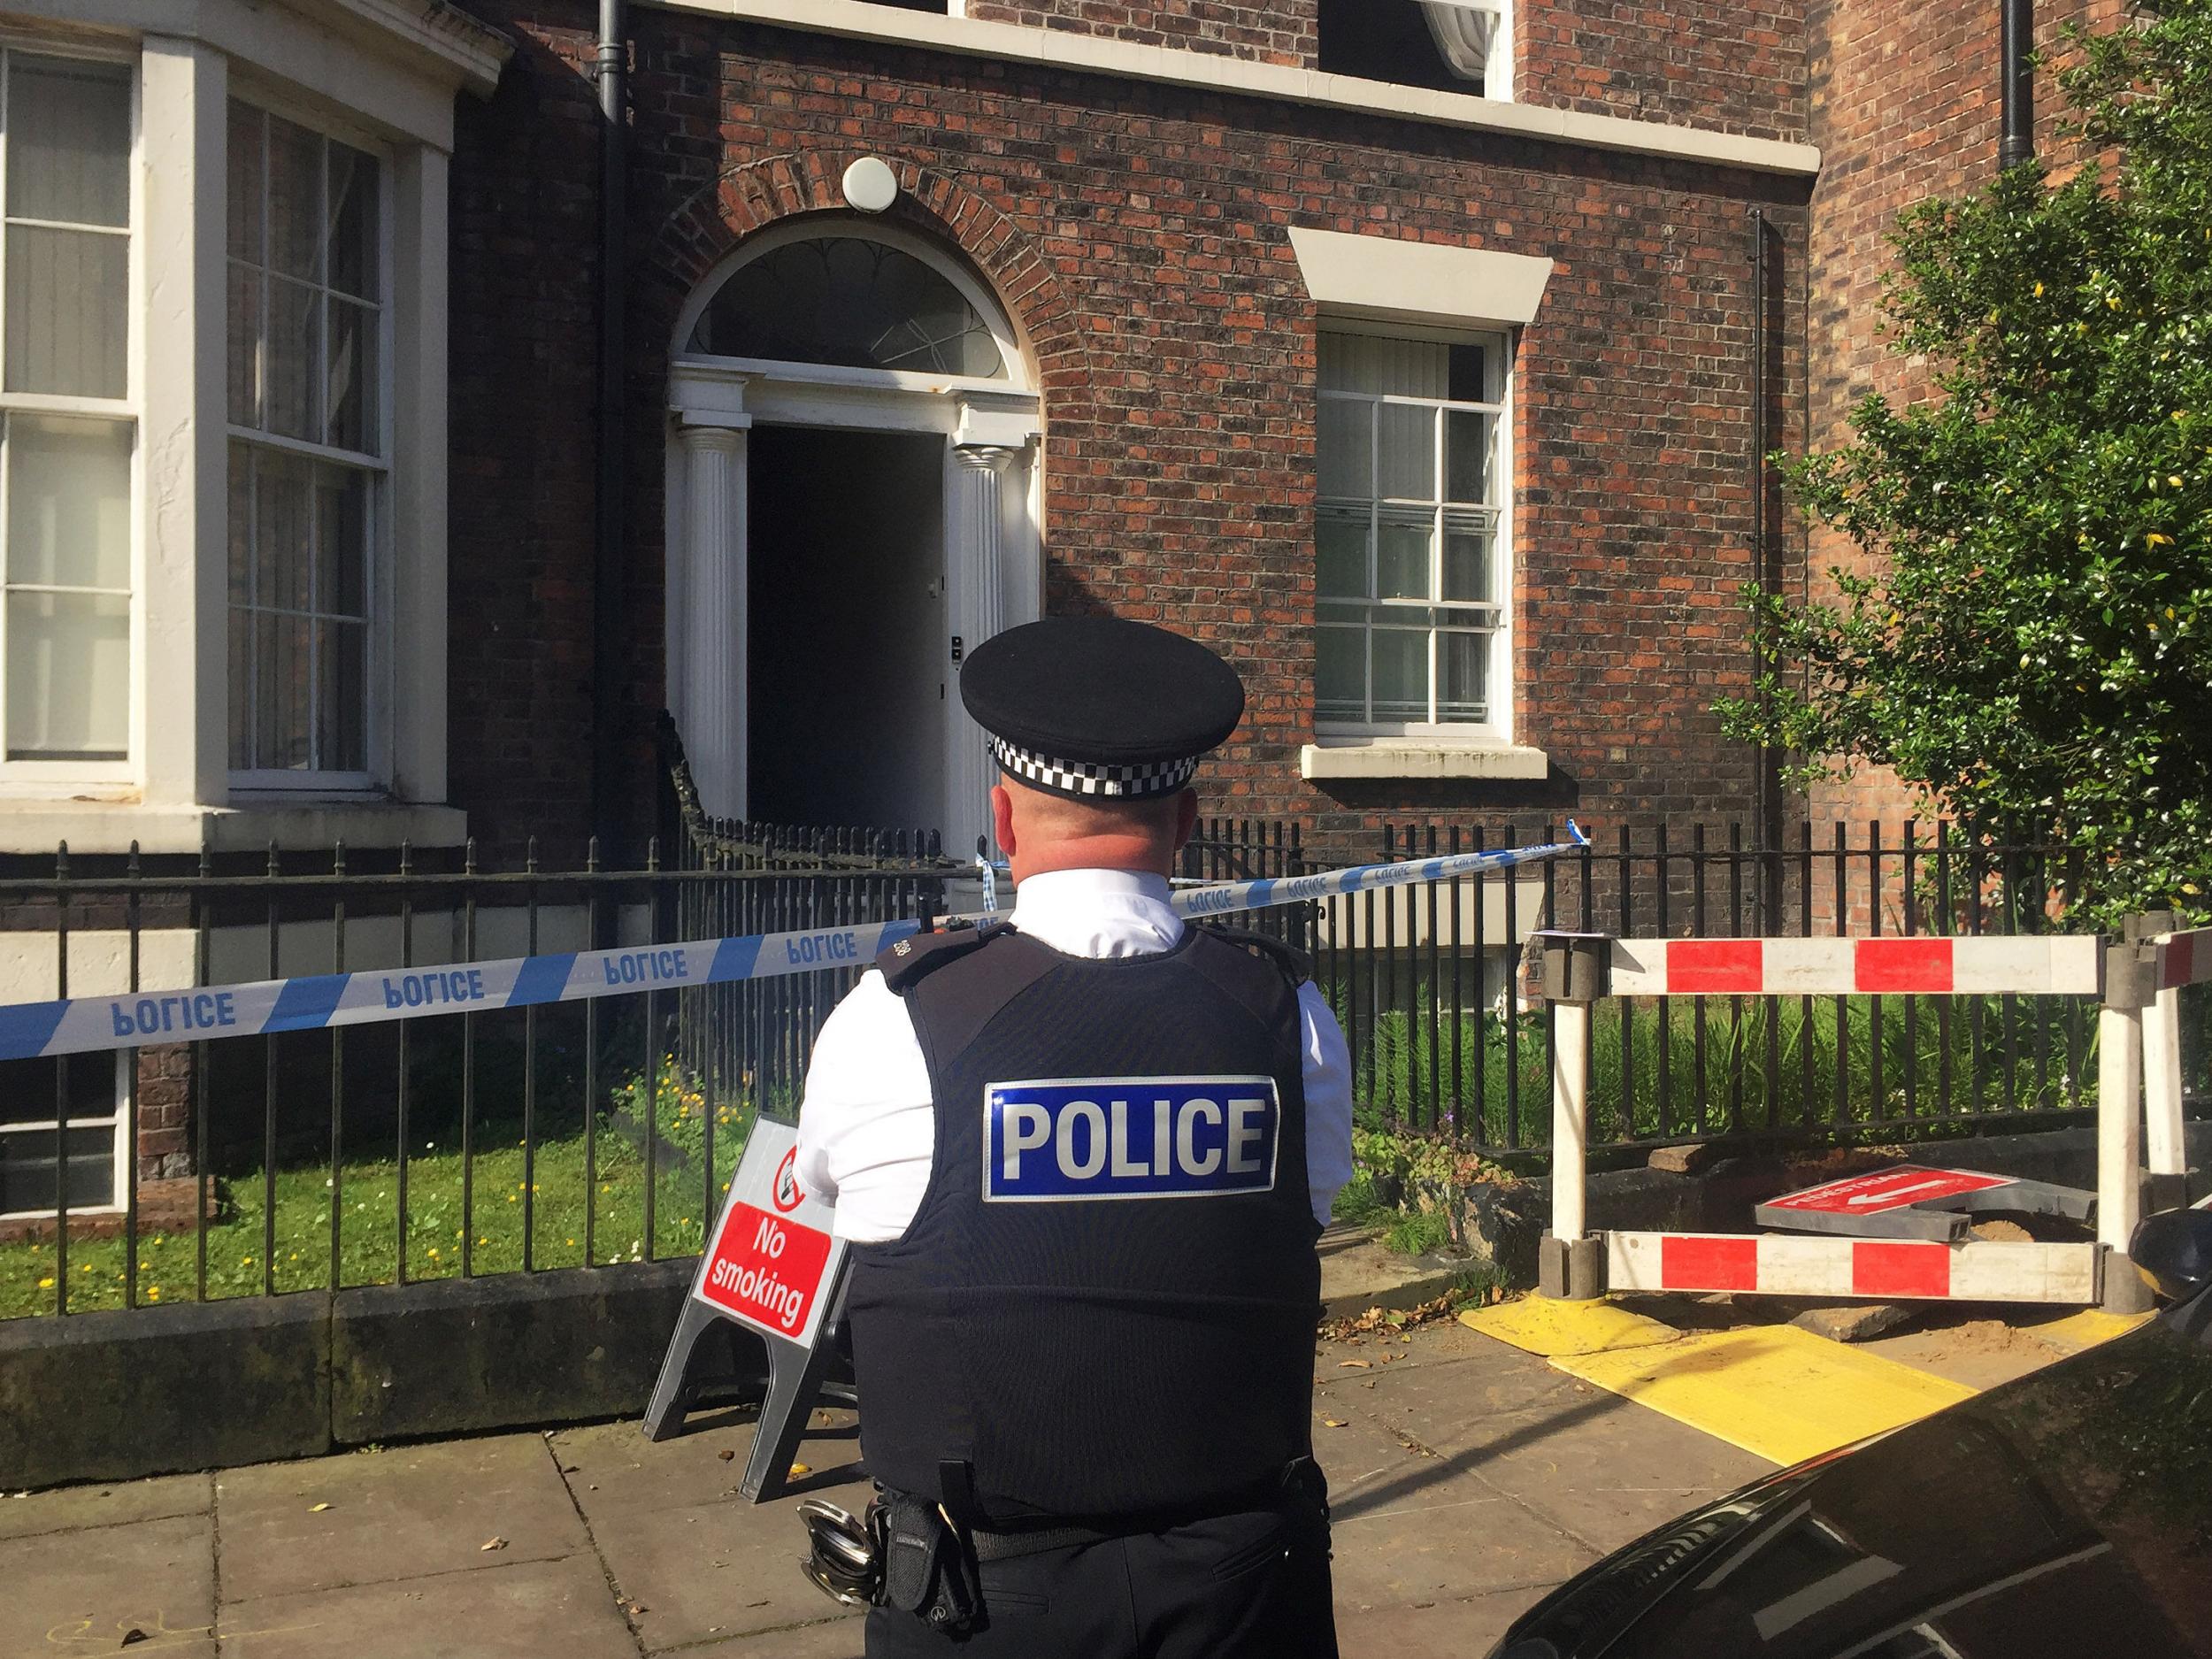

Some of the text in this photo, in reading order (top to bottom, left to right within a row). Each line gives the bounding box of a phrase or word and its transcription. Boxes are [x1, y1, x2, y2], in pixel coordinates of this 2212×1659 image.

[1002, 1098, 1266, 1180] POLICE
[752, 1217, 787, 1259] No
[711, 1257, 804, 1328] smoking
